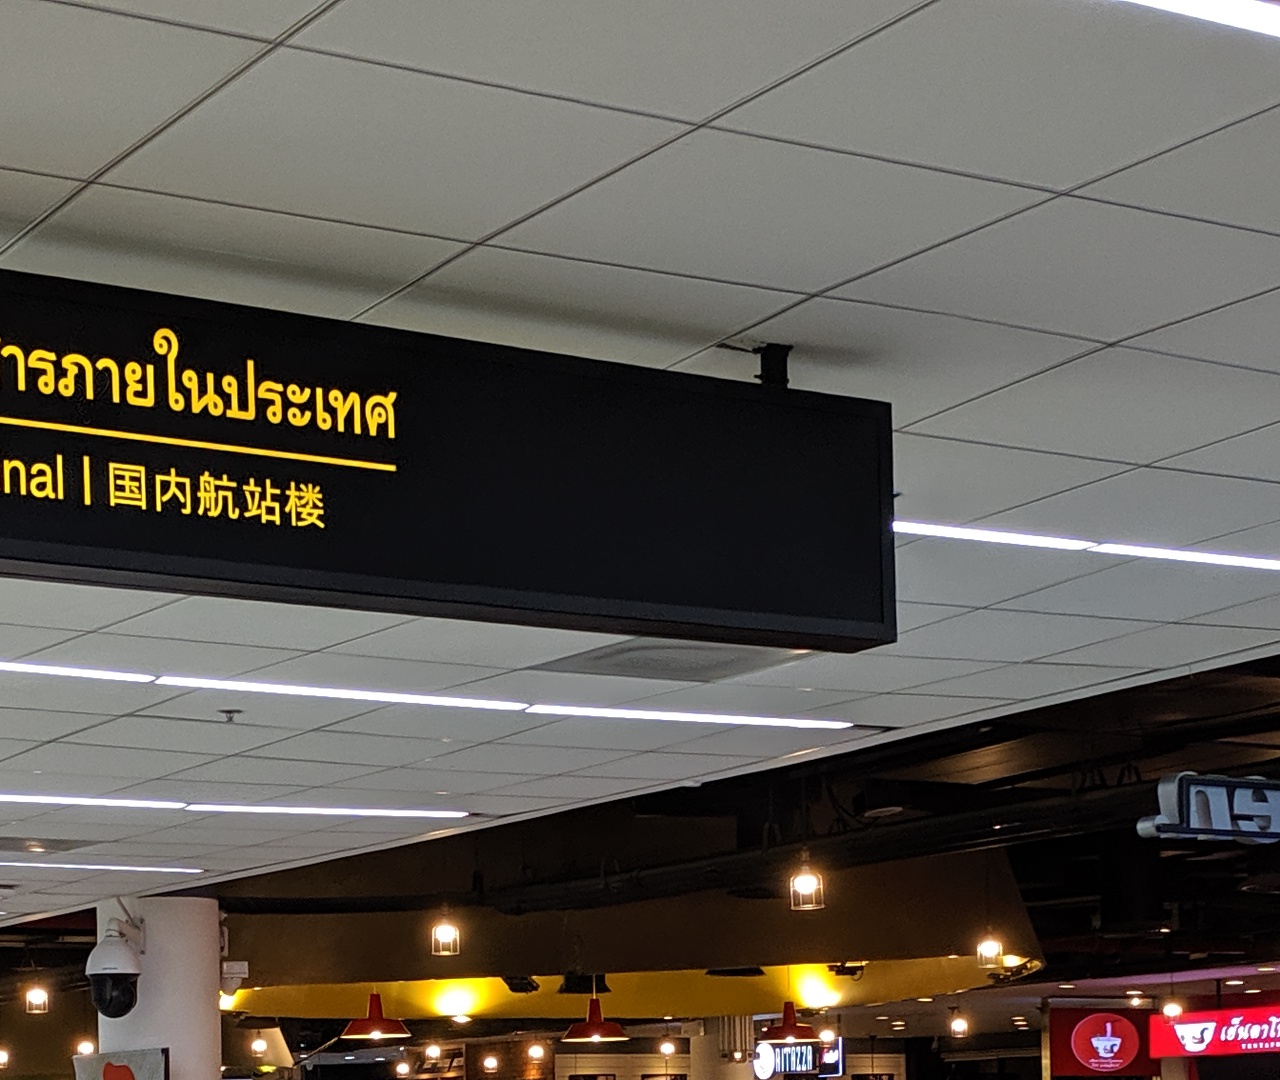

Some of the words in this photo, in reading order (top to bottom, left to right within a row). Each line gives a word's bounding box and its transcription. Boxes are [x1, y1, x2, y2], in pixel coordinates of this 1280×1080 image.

[108, 462, 326, 529] 国内航站楼
